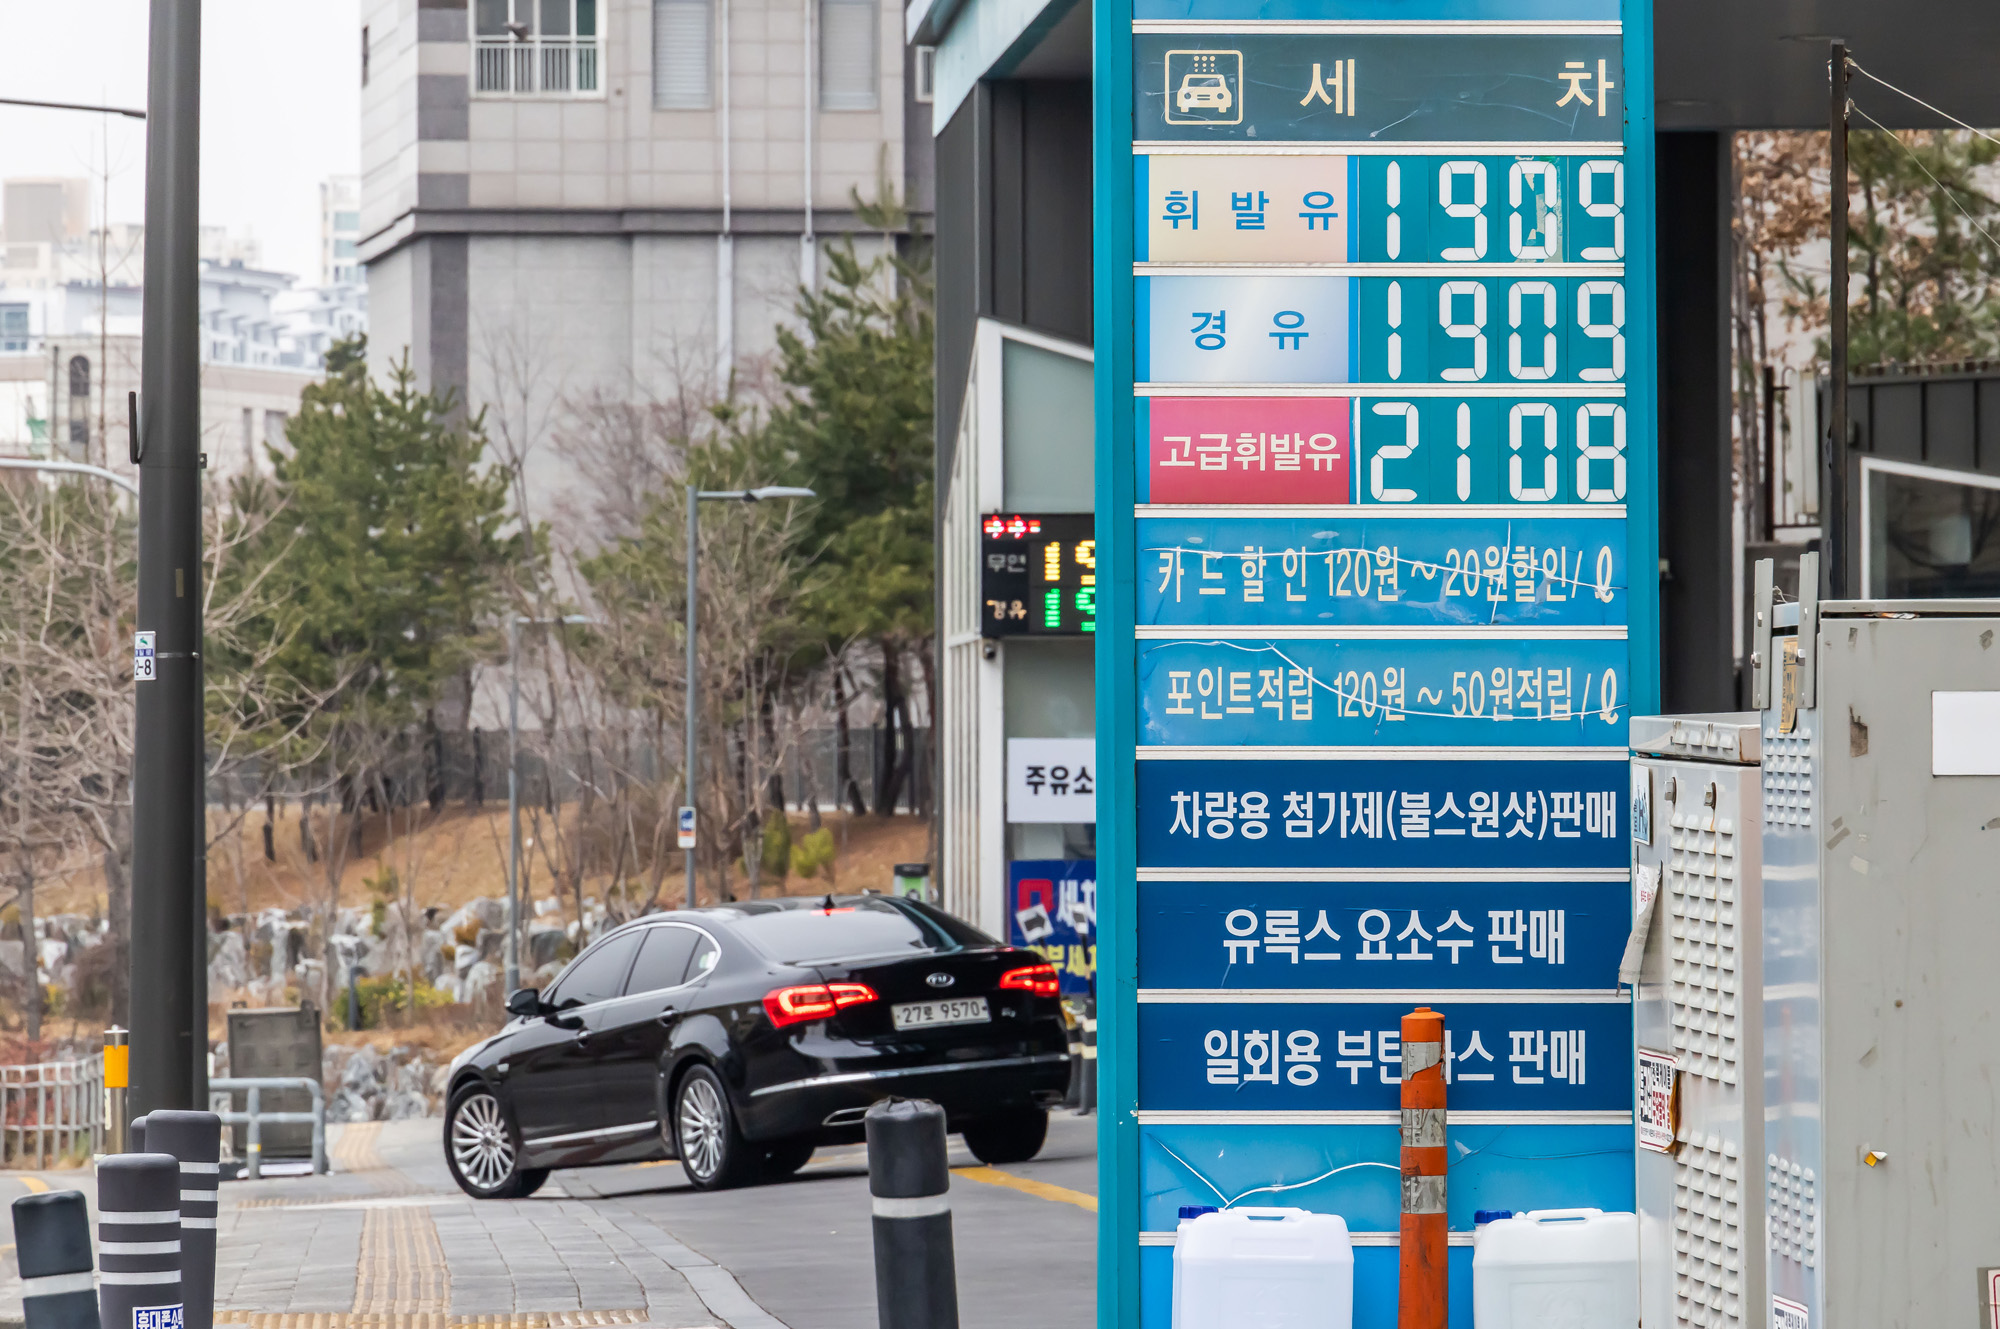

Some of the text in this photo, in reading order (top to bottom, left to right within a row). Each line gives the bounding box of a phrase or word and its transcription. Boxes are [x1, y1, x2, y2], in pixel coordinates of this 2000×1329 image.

[1387, 160, 1624, 260] 1909
[1388, 281, 1625, 380] 1909
[1160, 402, 1626, 502] 고급휘발유 2108
[1325, 546, 1399, 602] 120원
[1166, 667, 1313, 721] 포인트적립
[1334, 667, 1406, 721] 120원
[1027, 766, 1093, 795] 주유소
[1169, 791, 1270, 839] 차량용
[1223, 909, 1565, 964] 유록스 요소수 판매
[940, 1001, 980, 1019] 9570
[1204, 1030, 1321, 1086] 일회용
[1509, 1030, 1585, 1085] 판매
